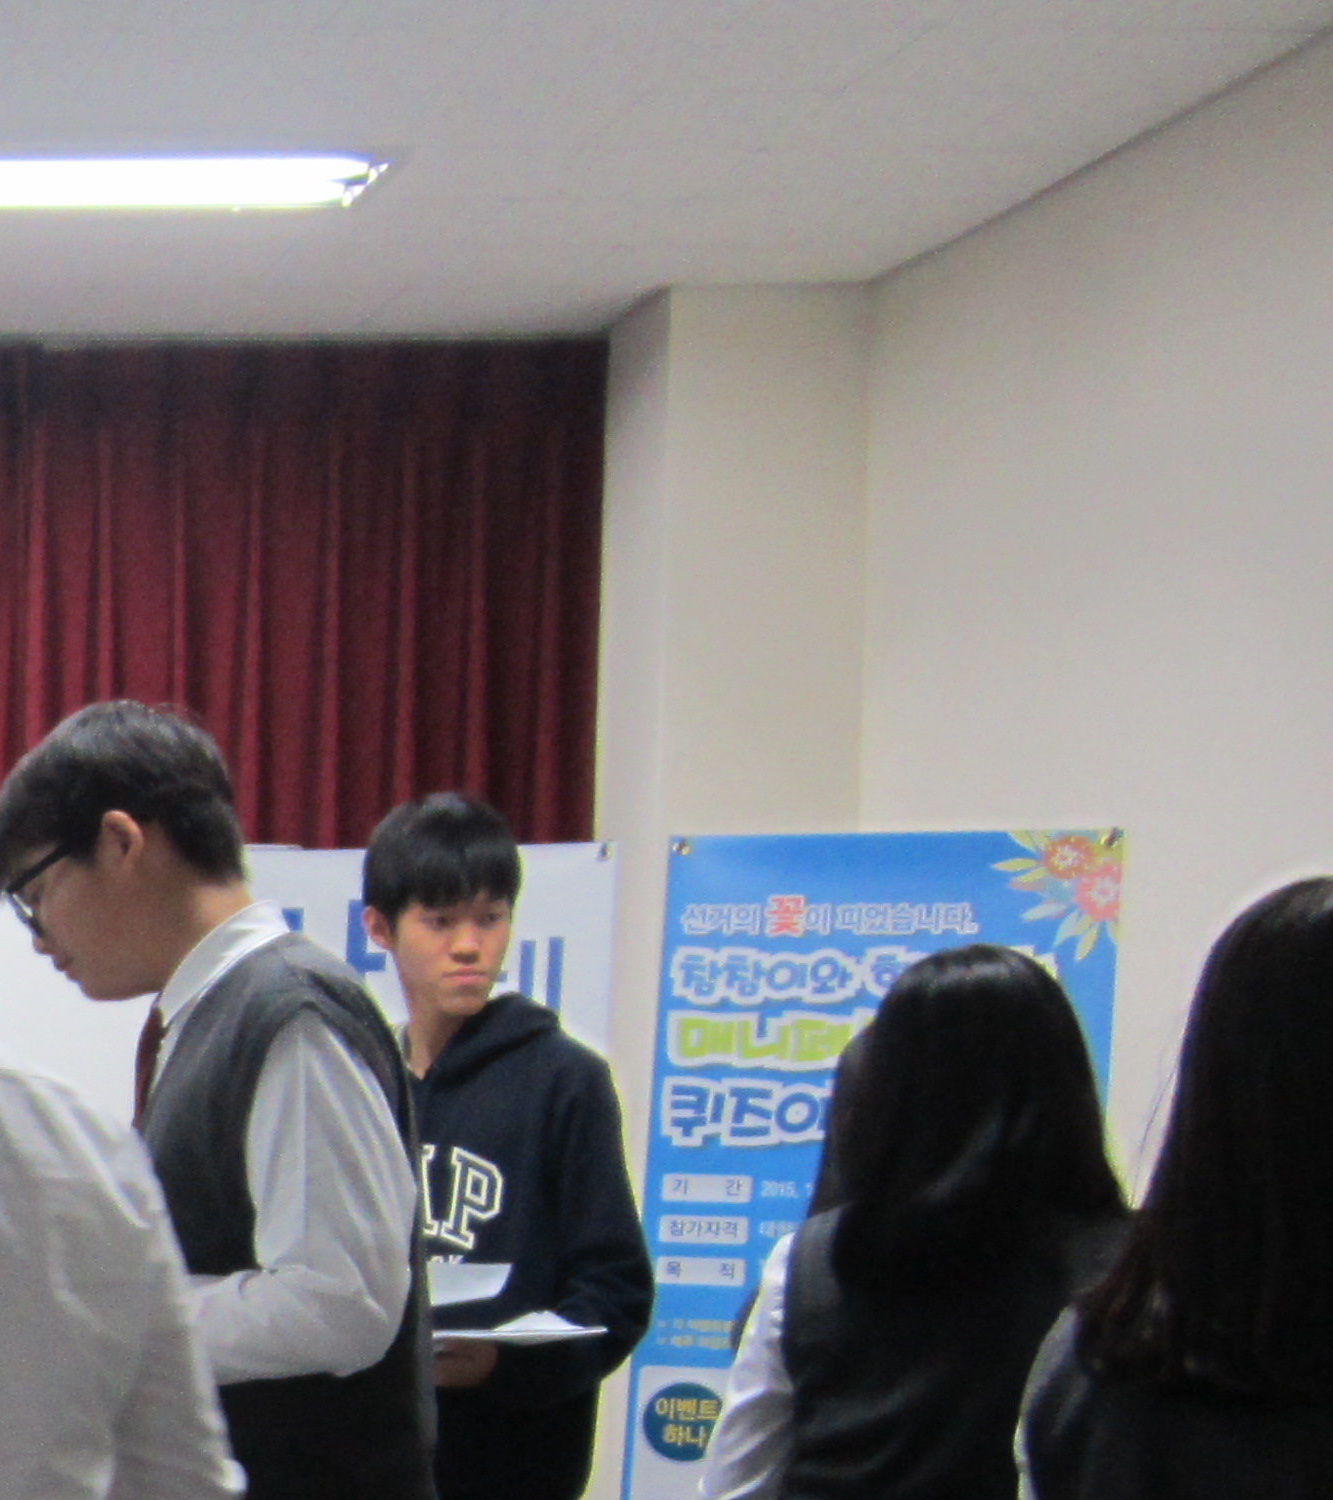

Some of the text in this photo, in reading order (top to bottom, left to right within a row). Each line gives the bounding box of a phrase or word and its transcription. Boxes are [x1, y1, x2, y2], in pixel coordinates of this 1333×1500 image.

[681, 903, 760, 935] 선거의
[765, 895, 831, 936] 꽃이
[677, 1014, 875, 1063] 매니페
[669, 1219, 739, 1238] 참가자격
[655, 1398, 720, 1421] 이벤트
